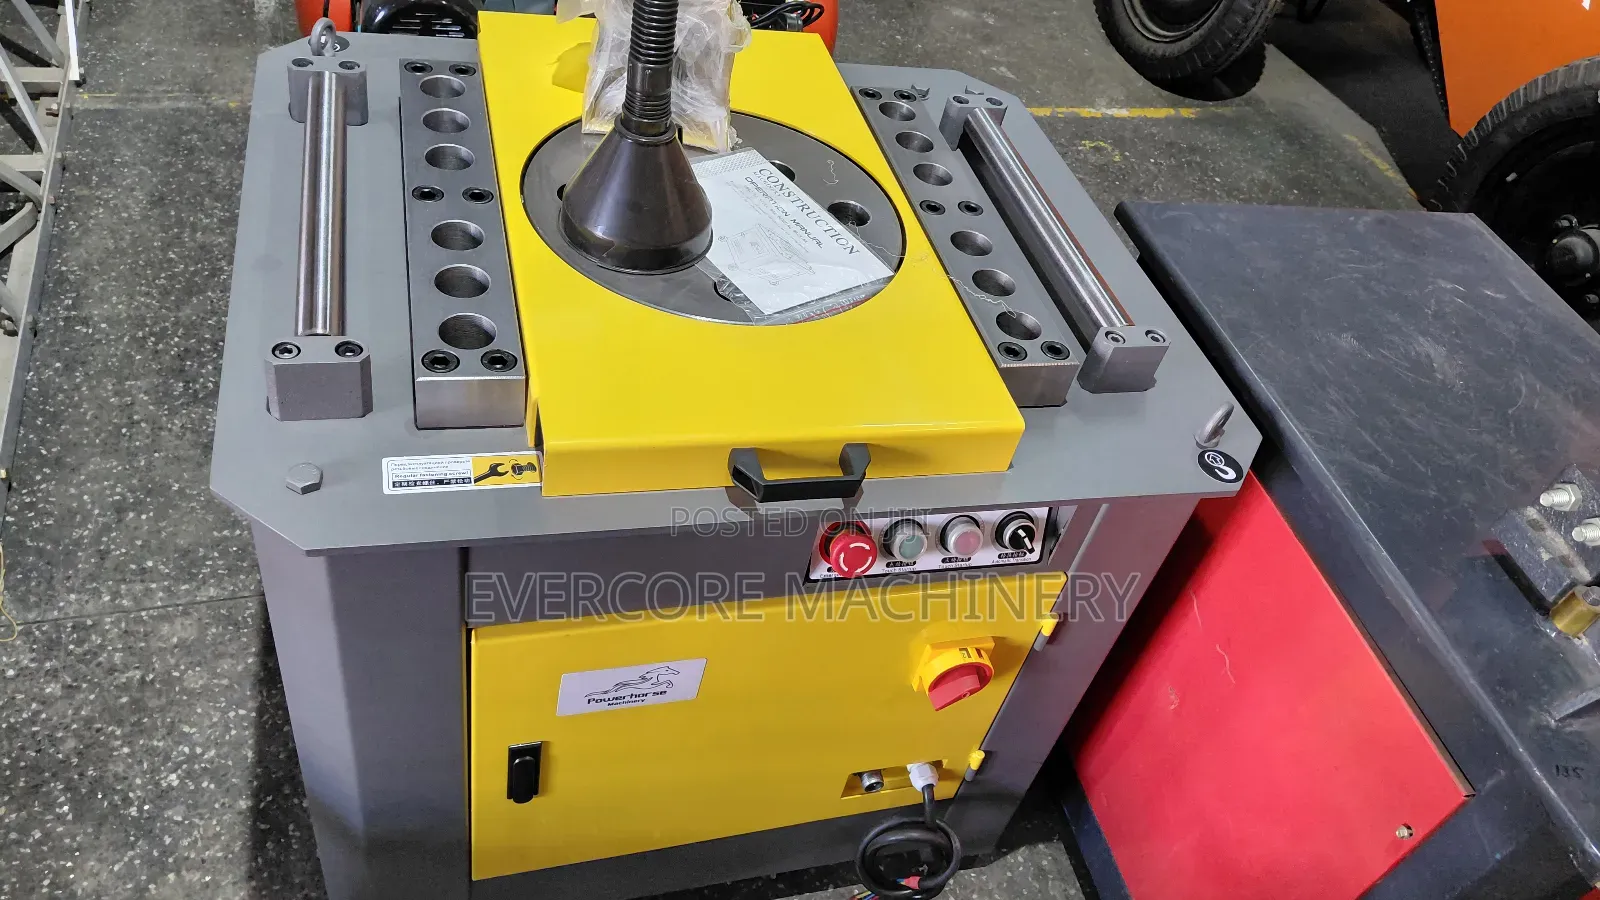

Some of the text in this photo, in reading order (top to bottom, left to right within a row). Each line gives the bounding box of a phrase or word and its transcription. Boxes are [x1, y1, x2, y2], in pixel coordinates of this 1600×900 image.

[744, 176, 791, 217] OPERATION
[789, 218, 824, 249] MANUAL
[758, 167, 860, 255] CONSTRUCTION
[587, 689, 668, 704] Powerhorse
[607, 698, 646, 707] Machinery
